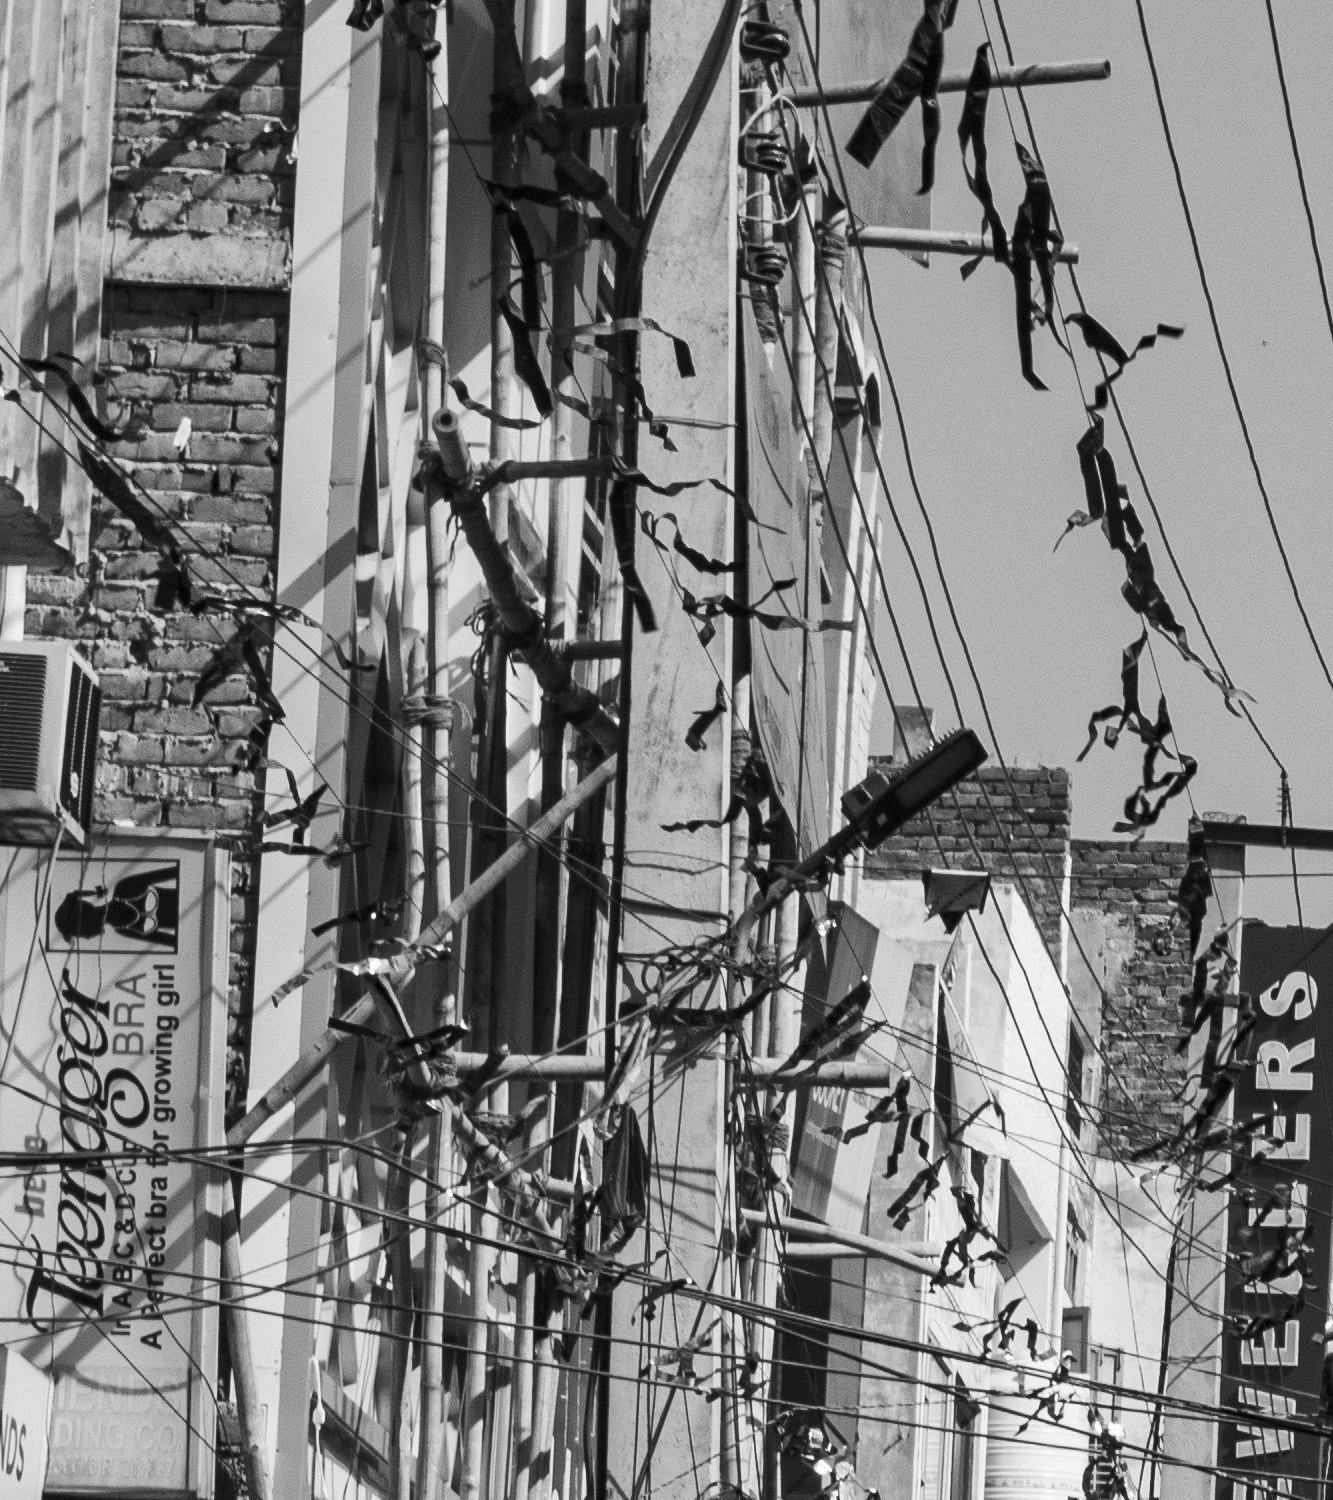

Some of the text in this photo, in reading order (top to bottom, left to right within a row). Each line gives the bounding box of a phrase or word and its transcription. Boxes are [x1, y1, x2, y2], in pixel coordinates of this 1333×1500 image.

[112, 973, 146, 1056] BRA
[153, 963, 180, 1007] girl
[150, 1014, 179, 1123] growing
[26, 967, 150, 1332] Teenager
[146, 1177, 168, 1219] bra
